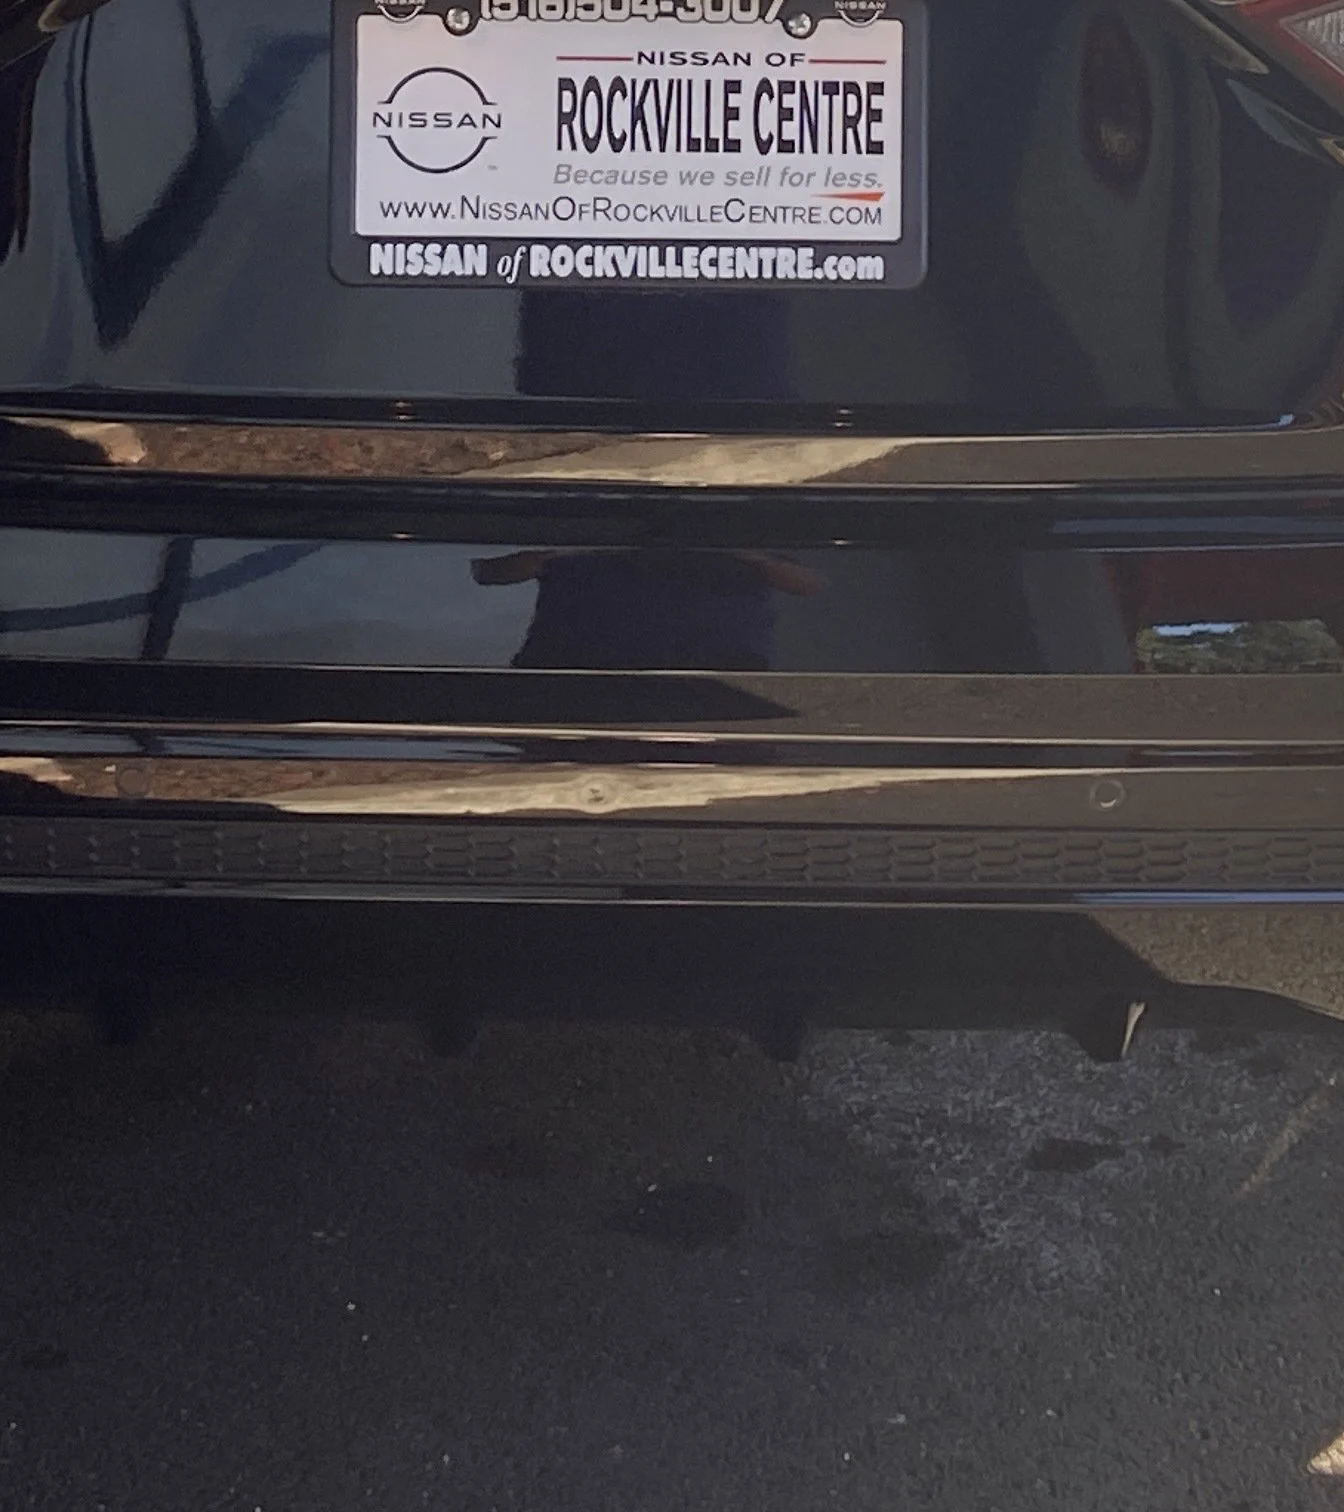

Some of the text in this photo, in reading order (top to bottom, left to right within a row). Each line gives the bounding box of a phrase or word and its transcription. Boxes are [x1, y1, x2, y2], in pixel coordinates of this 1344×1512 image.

[834, 0, 887, 11] NISSAN
[636, 50, 807, 68] NISSAN OF
[372, 110, 502, 130] NISSAN
[556, 74, 886, 157] ROCKVILLE CENTRE
[553, 162, 884, 190] Because we sell for less.
[369, 242, 886, 285] NISSAN of ROCKVILLECENTRE.com
